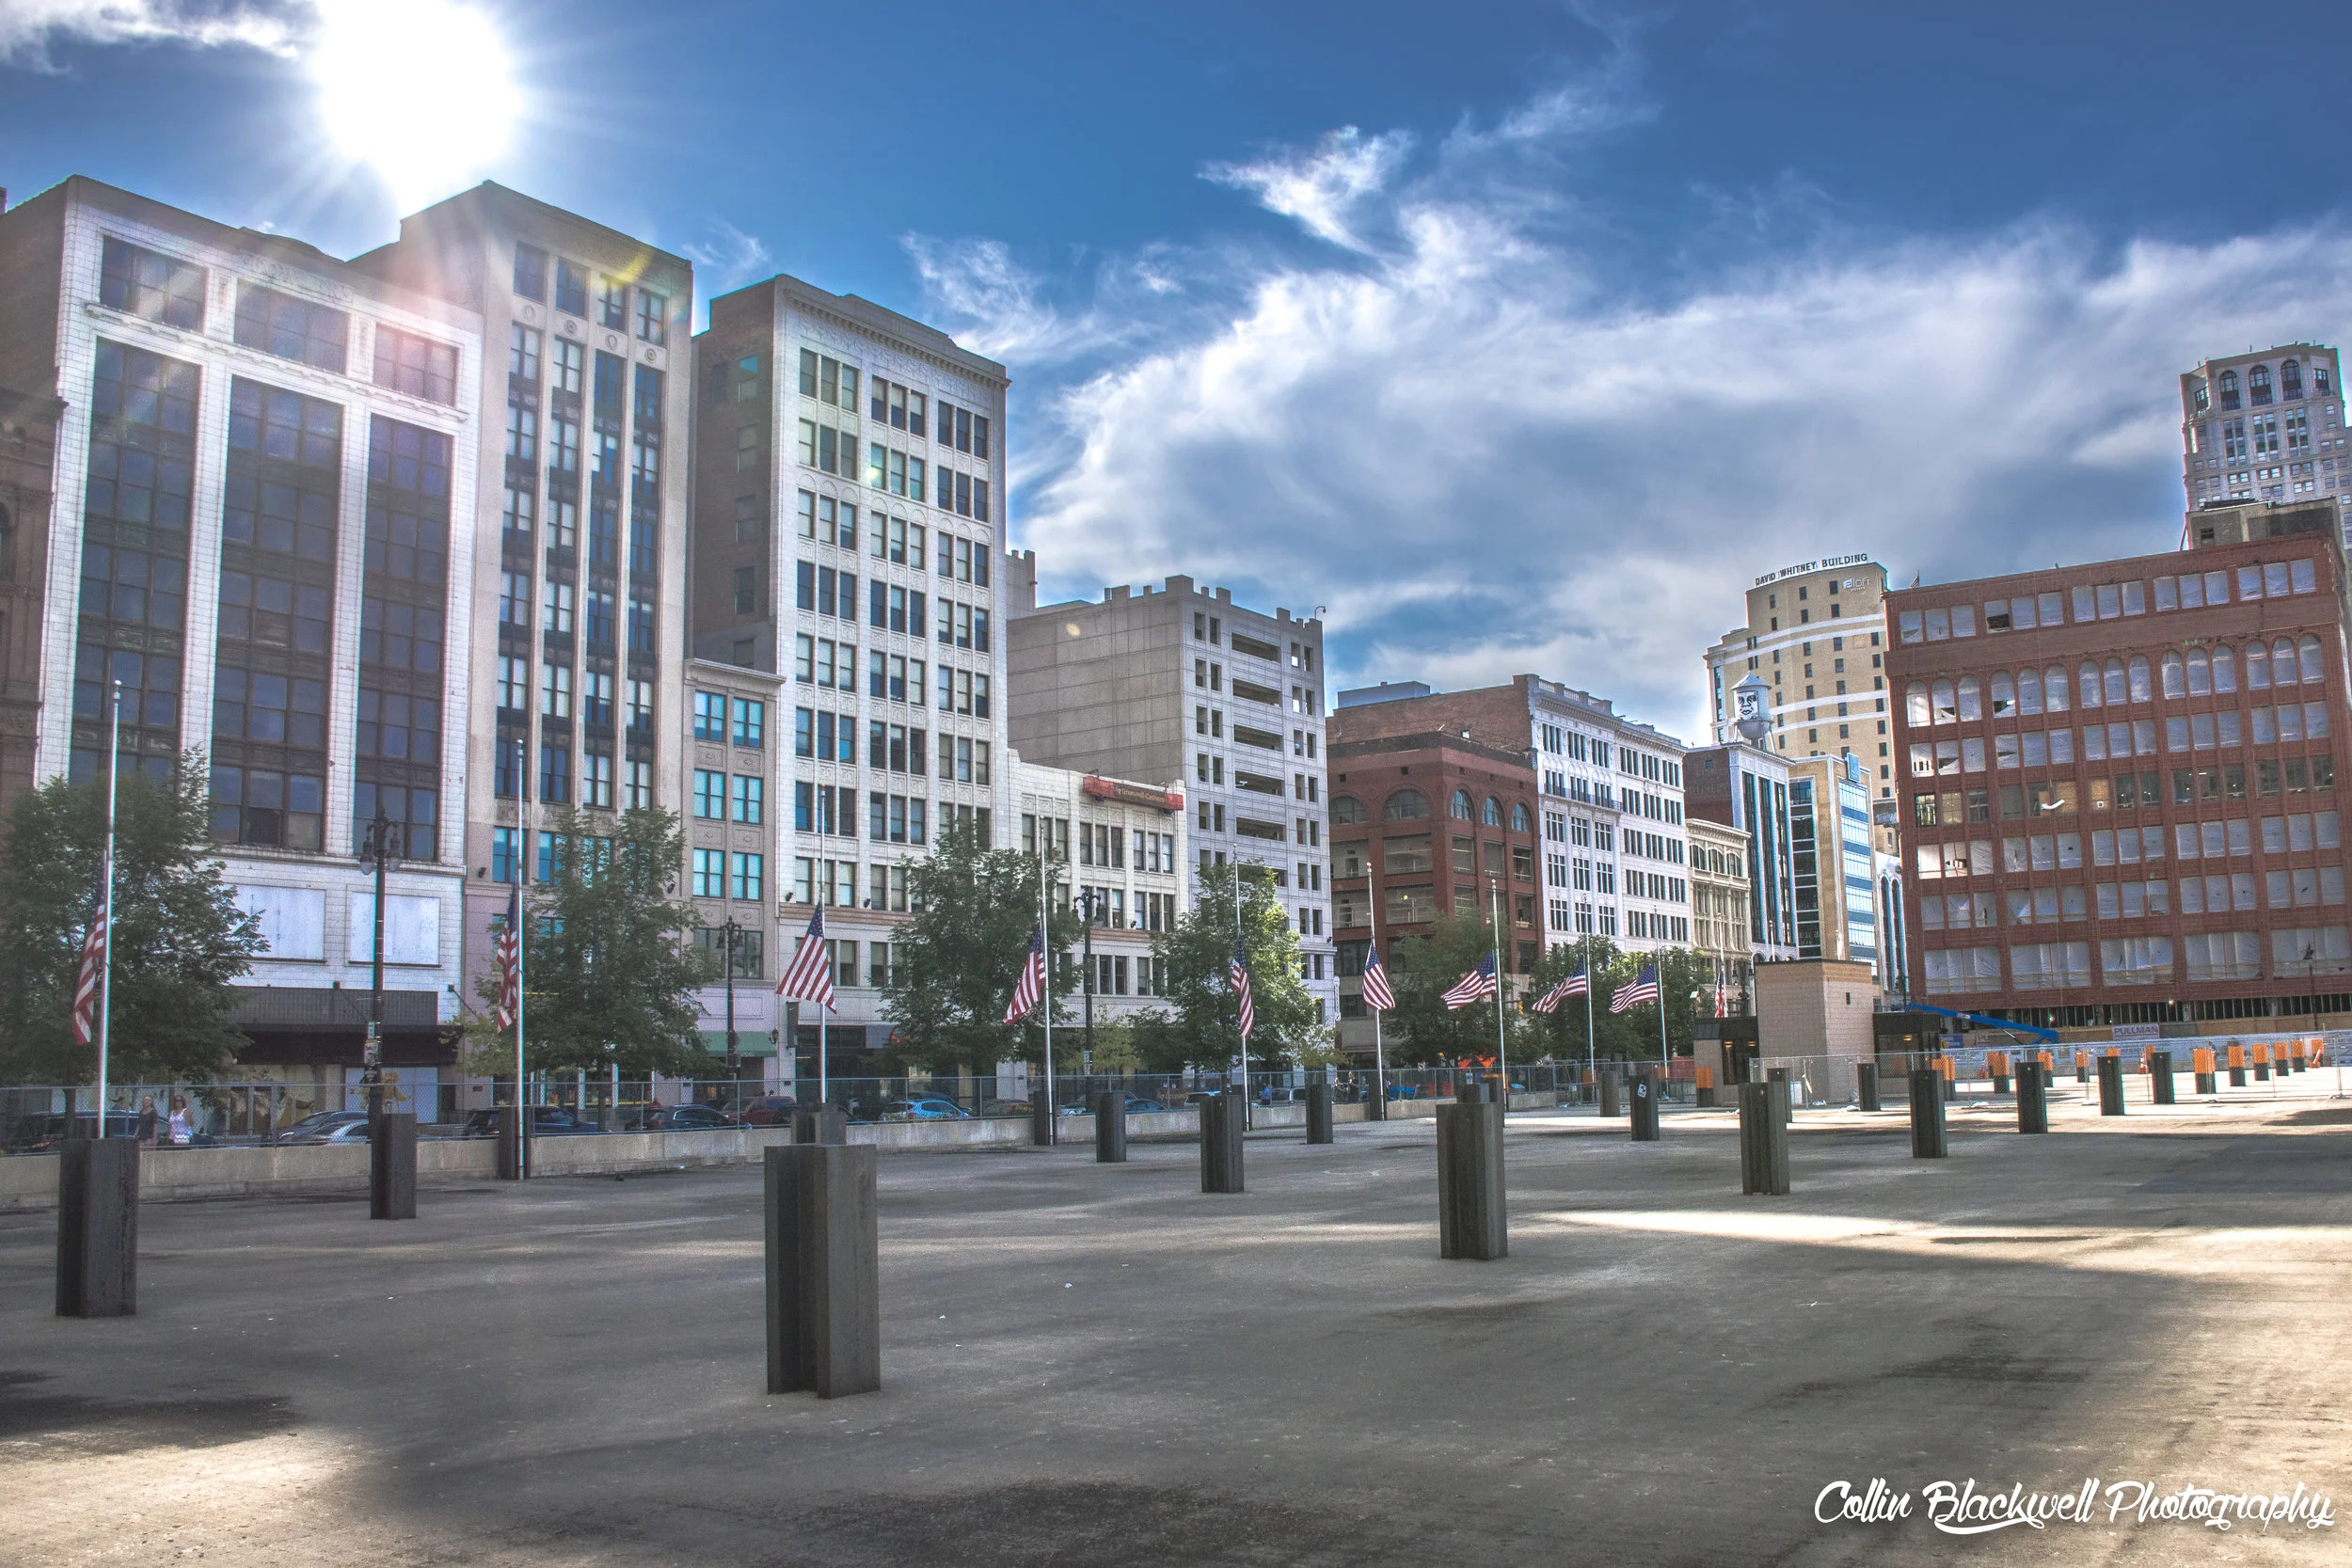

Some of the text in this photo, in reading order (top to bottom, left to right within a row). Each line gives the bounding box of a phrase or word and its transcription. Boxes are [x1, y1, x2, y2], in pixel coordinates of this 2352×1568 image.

[1755, 553, 1867, 587] DAVID WHITNEY BUILDING
[2114, 1026, 2158, 1035] PULLMAN
